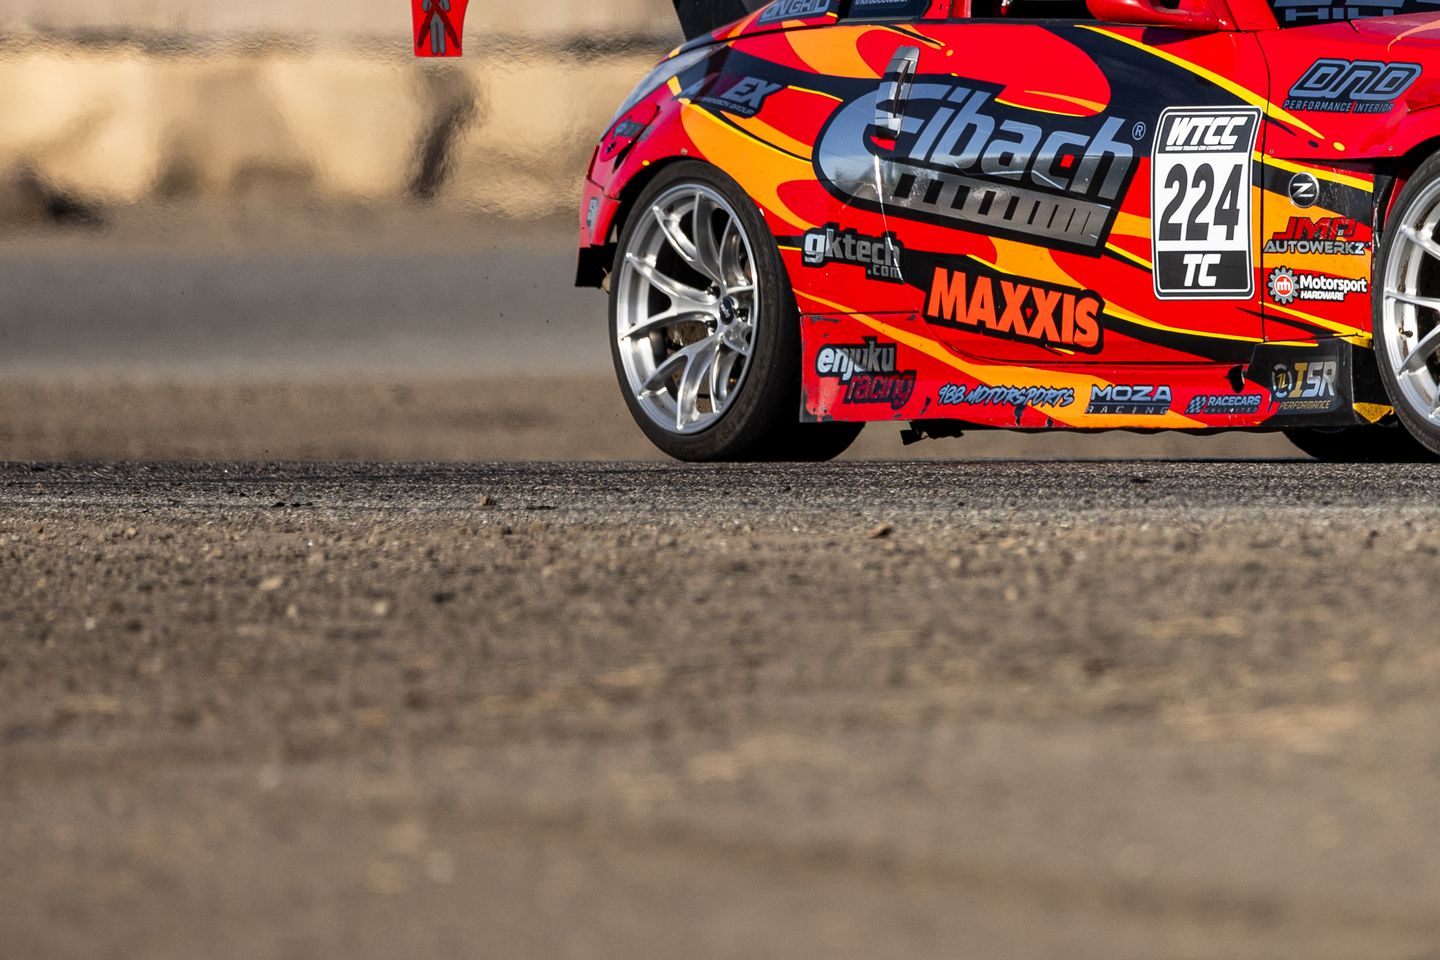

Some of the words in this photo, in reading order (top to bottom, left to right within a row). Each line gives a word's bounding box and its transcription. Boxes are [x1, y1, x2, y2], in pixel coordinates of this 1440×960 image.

[1283, 99, 1352, 113] PERFORMANCE
[1353, 102, 1395, 113] INTERIOR
[819, 80, 1134, 206] Eibach
[1166, 116, 1248, 146] WTCC
[1158, 162, 1243, 241] 224
[1272, 216, 1357, 240] JMP
[803, 228, 901, 264] gktech
[1264, 240, 1366, 255] AUTOWERKZ
[1183, 253, 1221, 287] TC
[1300, 274, 1368, 293] Motorsport
[927, 267, 1100, 348] MAXXIS
[1300, 291, 1345, 301] HARDWARE
[817, 341, 896, 381] enjuku
[849, 374, 914, 406] racing
[1288, 361, 1337, 398] ISR
[964, 384, 1075, 407] MOTORSPORTS
[1090, 385, 1172, 402] MOZA
[1207, 395, 1261, 406] RACECARS
[1279, 400, 1331, 410] PERFORMANCE
[1086, 405, 1169, 415] RACING
